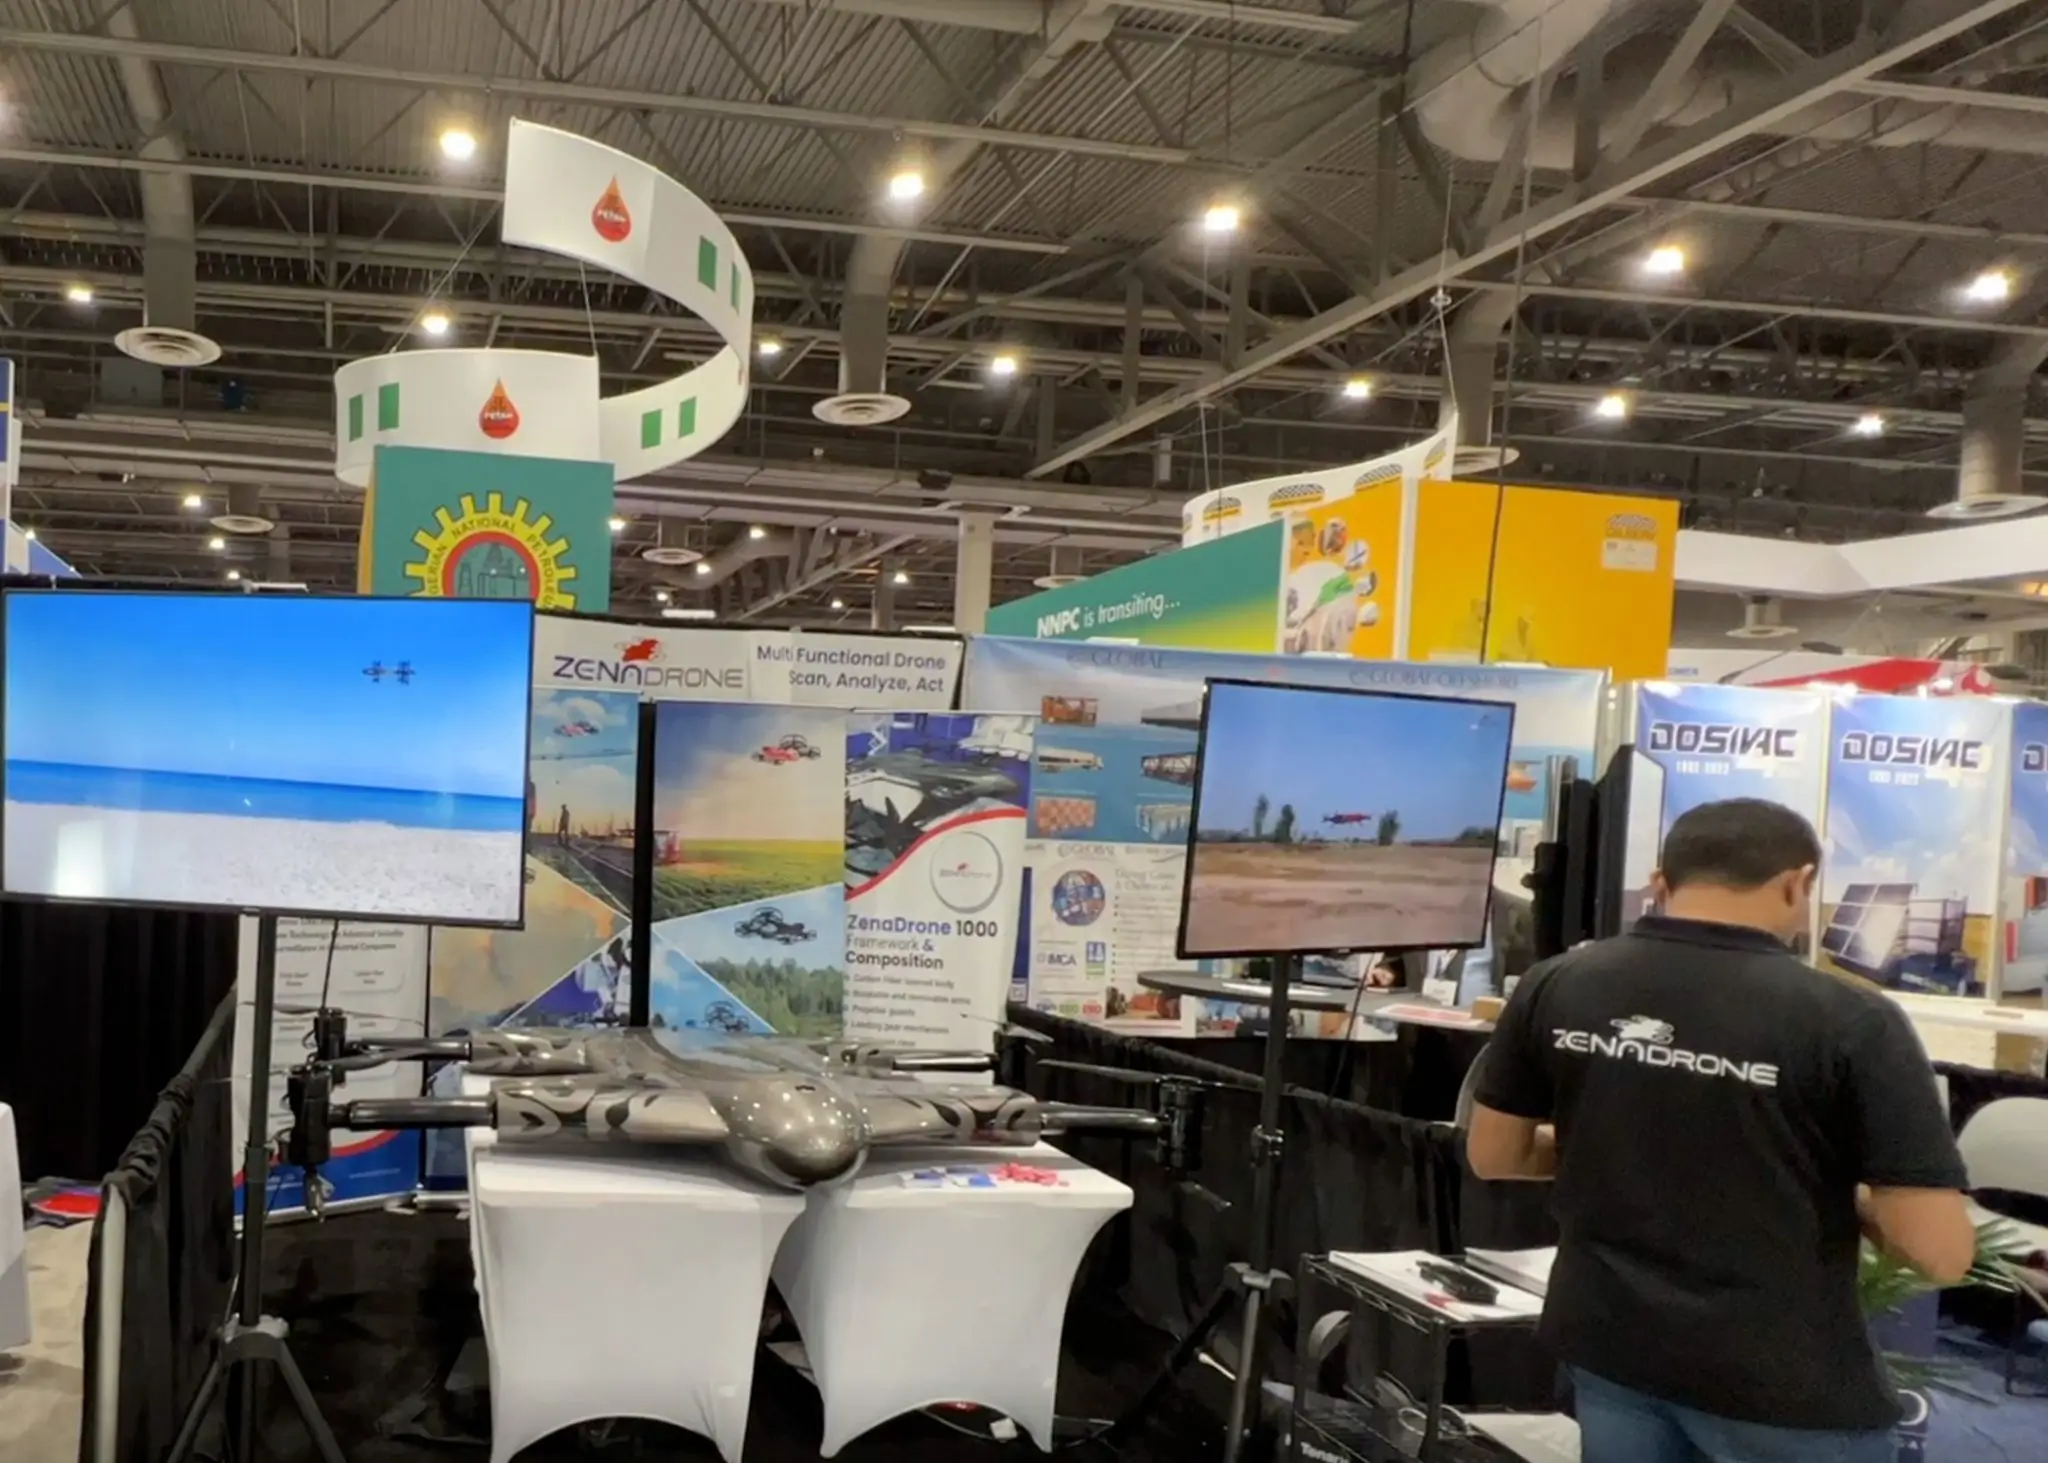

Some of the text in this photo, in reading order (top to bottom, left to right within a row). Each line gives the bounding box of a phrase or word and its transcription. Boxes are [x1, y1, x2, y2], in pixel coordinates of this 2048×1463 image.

[428, 518, 555, 607] GERIAN NATIONAL PETROLEU
[1037, 606, 1080, 639] NNPC
[1084, 606, 1095, 628] is
[757, 645, 946, 670] Multi Functional Drone
[553, 654, 745, 688] ZENADRONE
[788, 670, 944, 694] Scan, Analyze, Act
[847, 915, 998, 937] ZenaDrone 1000
[847, 933, 934, 951] Framework &
[845, 950, 943, 969] Composition
[1552, 1029, 1779, 1087] ZENADRONE
